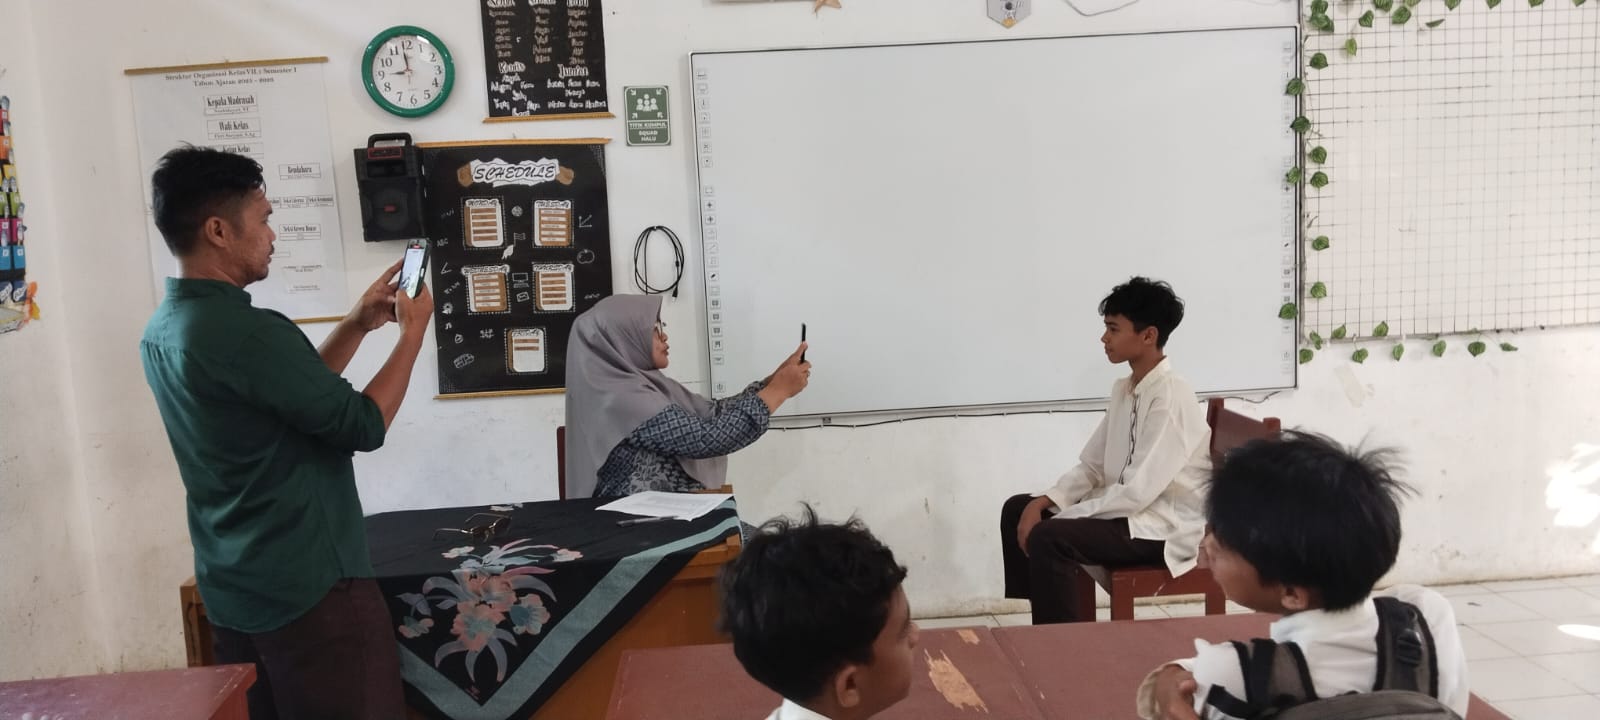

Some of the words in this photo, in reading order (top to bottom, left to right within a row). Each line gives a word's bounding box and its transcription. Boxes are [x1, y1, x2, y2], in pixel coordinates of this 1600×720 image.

[389, 46, 399, 56] 11
[419, 44, 423, 53] 1
[380, 57, 393, 68] 10
[430, 52, 437, 62] 2
[378, 70, 385, 80] 9
[434, 65, 442, 75] 3
[384, 82, 392, 92] 8
[432, 77, 440, 88] 4
[396, 91, 403, 102] 7
[410, 94, 418, 105] 6
[423, 89, 431, 100] 5
[207, 96, 227, 109] Kepala
[228, 95, 255, 105] Madrasah
[219, 121, 232, 131] Wali
[233, 120, 249, 130] Kelas
[474, 164, 556, 181] SCHEDULE
